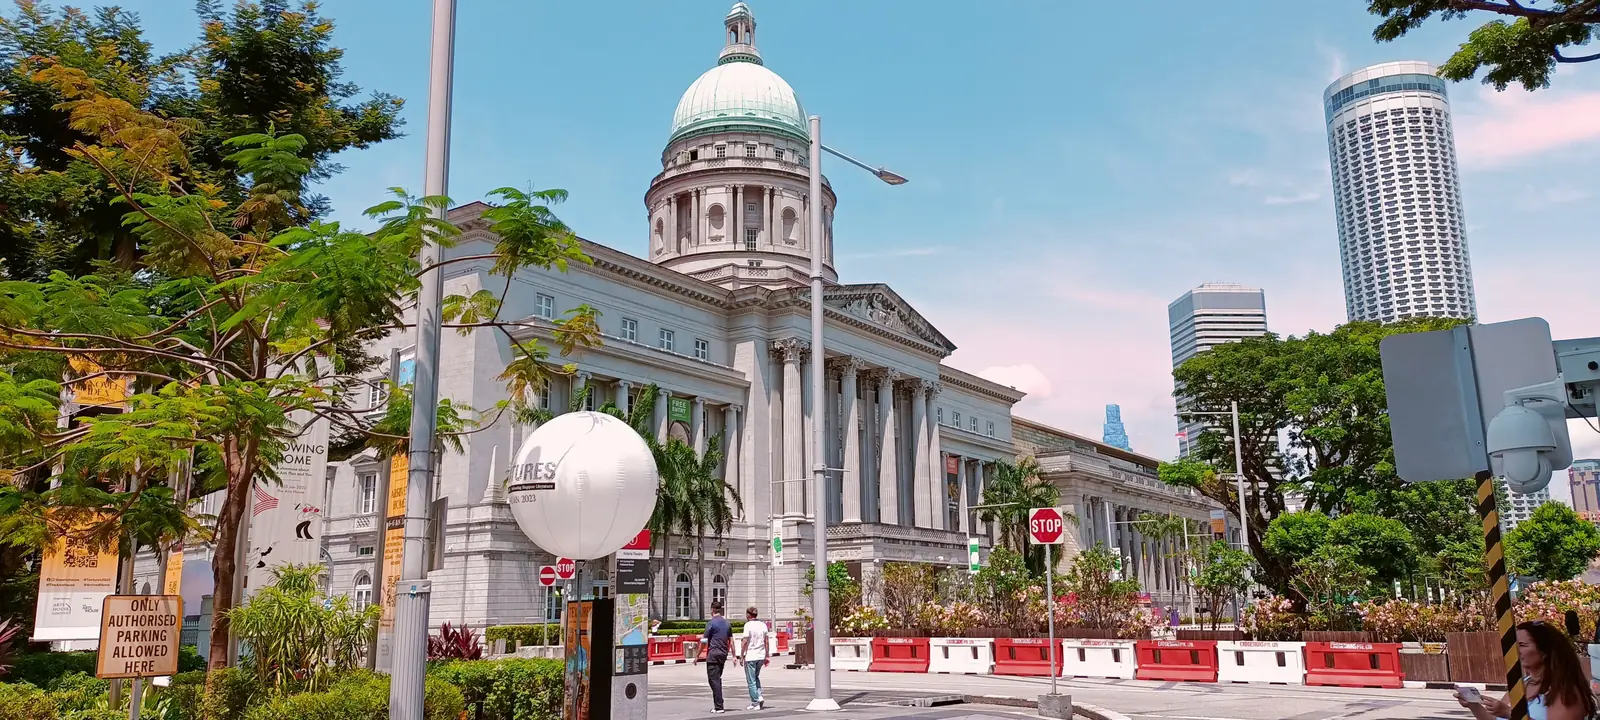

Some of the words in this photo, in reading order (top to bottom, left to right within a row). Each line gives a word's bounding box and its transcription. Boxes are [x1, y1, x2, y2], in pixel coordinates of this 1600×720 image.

[672, 399, 687, 408] FREE
[284, 454, 312, 466] OME
[521, 494, 537, 503] 2023
[1031, 518, 1062, 533] STOP
[557, 563, 574, 573] STOP
[131, 599, 160, 612] ONLY
[108, 614, 177, 628] AUTHORISED
[116, 629, 168, 643] PARKING
[112, 644, 168, 658] ALLOWED
[124, 660, 155, 674] HERE
